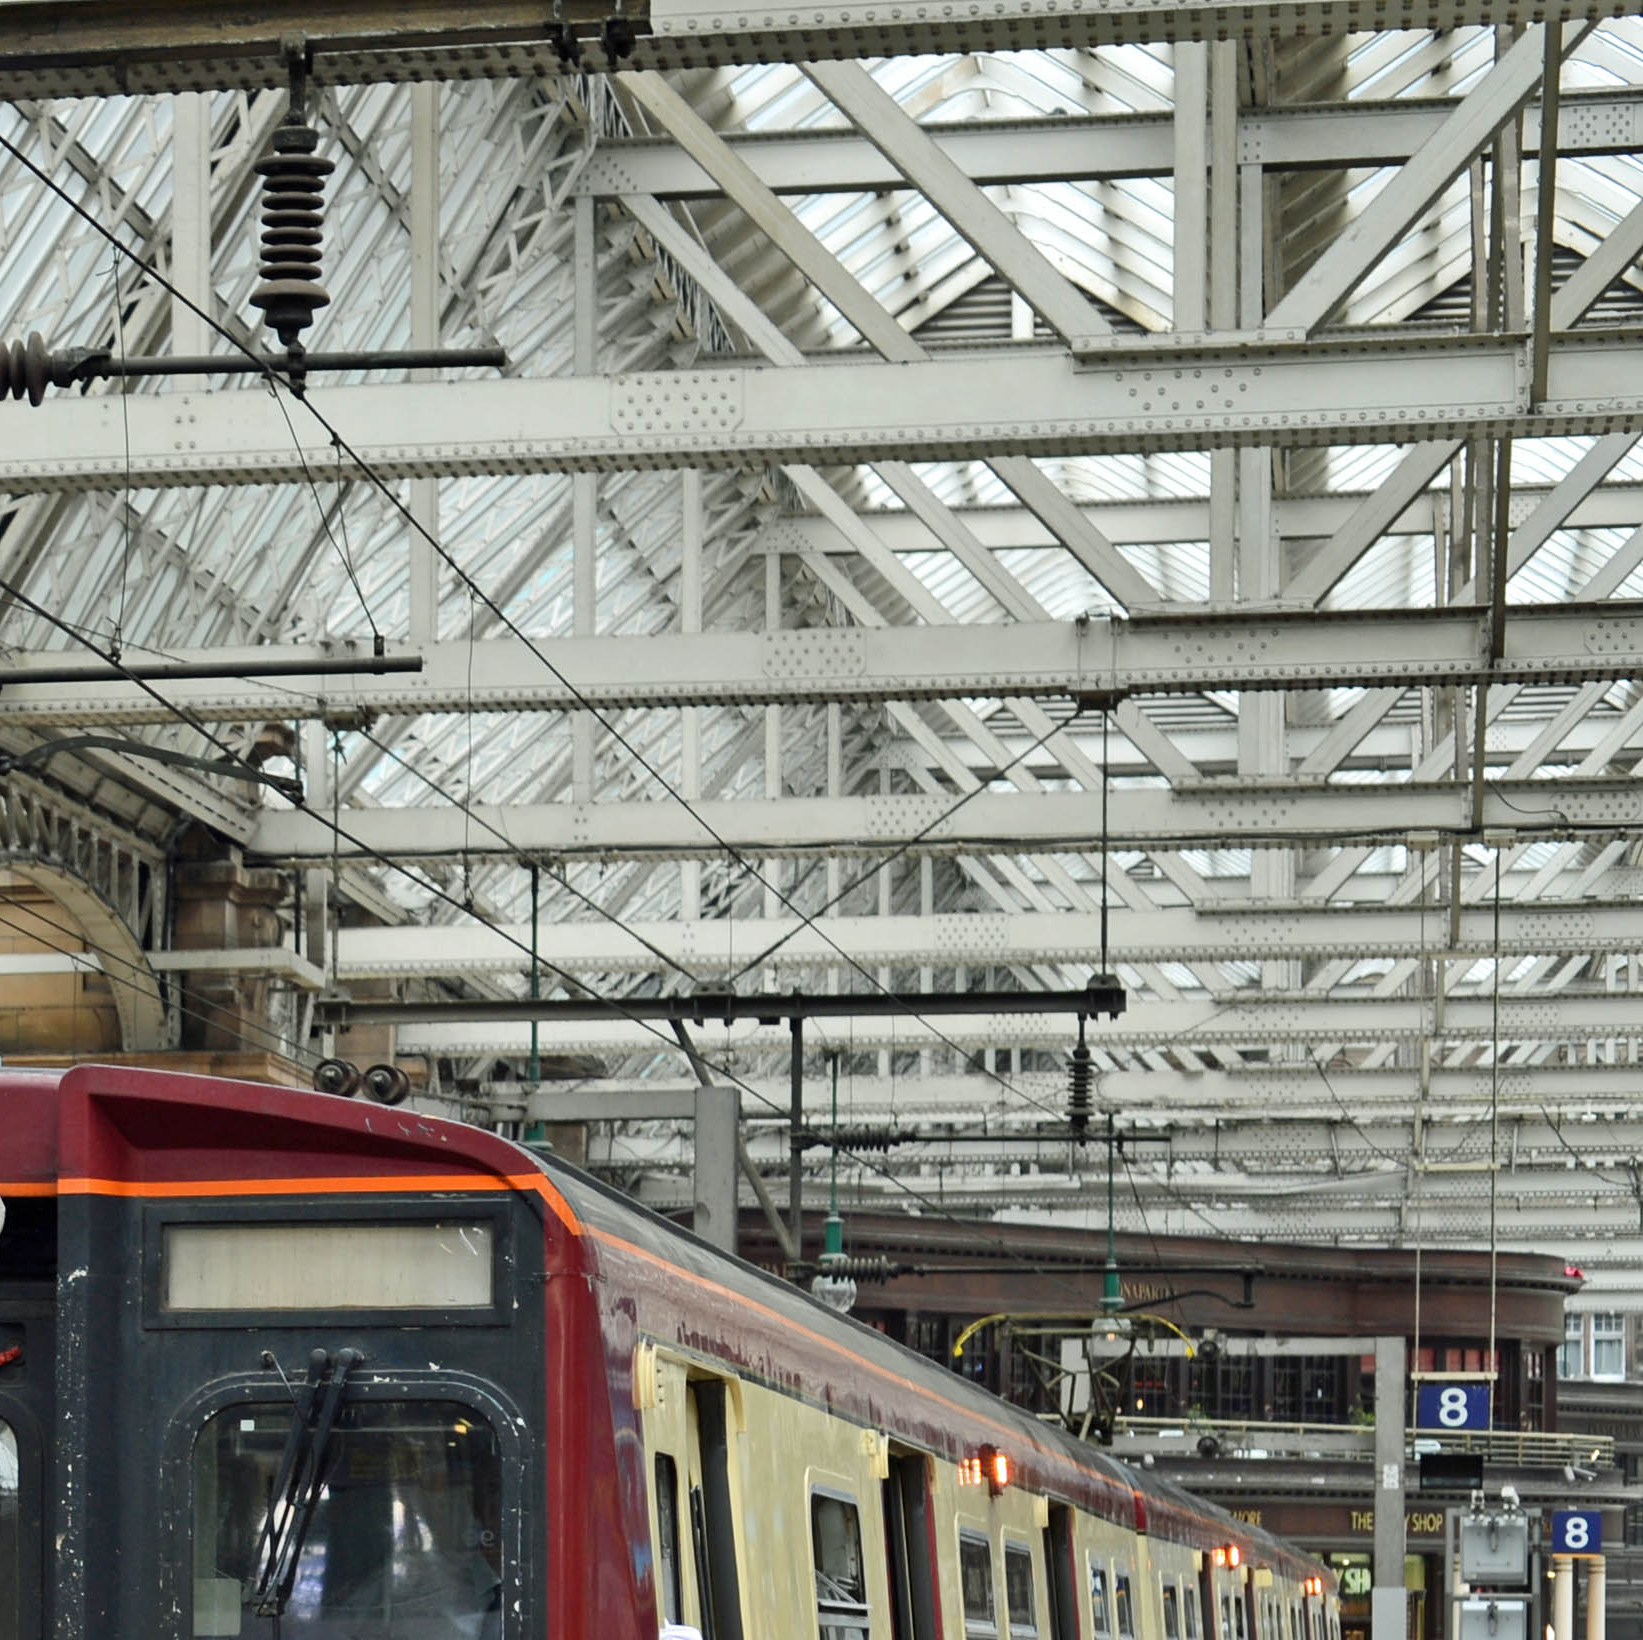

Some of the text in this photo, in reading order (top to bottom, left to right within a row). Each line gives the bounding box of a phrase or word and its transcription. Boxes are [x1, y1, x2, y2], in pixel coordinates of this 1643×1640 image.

[1438, 1386, 1469, 1428] 8
[1350, 1511, 1373, 1530] THE
[1412, 1512, 1443, 1533] SHOP
[1564, 1516, 1590, 1549] 8
